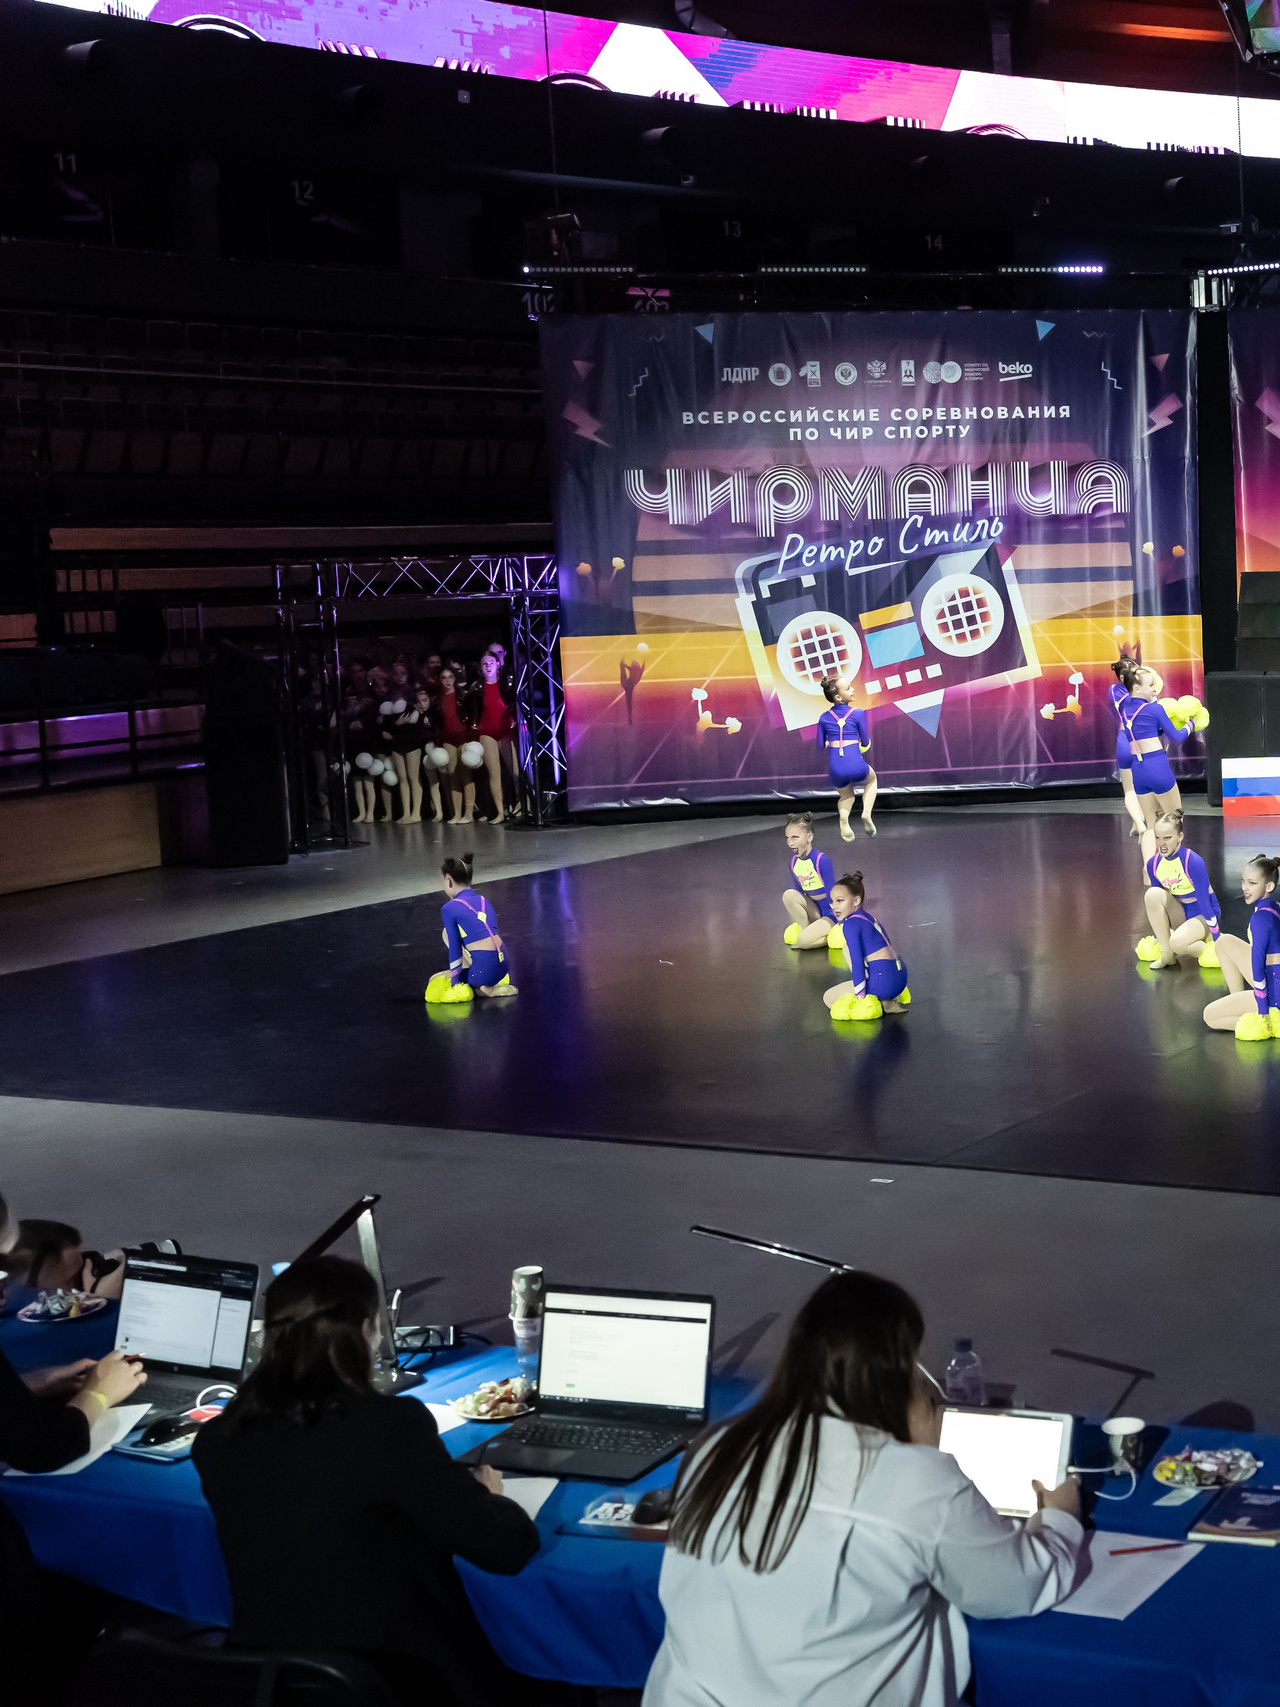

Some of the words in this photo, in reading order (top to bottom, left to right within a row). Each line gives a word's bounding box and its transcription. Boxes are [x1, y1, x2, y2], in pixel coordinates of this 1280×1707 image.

[53, 151, 76, 173] 11
[290, 179, 314, 200] 12
[722, 219, 741, 238] 13
[924, 234, 943, 251] 14
[721, 367, 760, 384] ЛДПР
[998, 361, 1033, 374] beko
[682, 406, 880, 425] ВСЕРОССИЙСКИЕ
[890, 405, 1072, 421] СОРЕВНОВАНИЯ
[789, 427, 819, 441] ПО
[830, 426, 874, 441] ЧИР
[884, 424, 972, 440] СПОРТУ
[778, 533, 884, 575] Ретро
[899, 514, 1004, 554] Стиль
